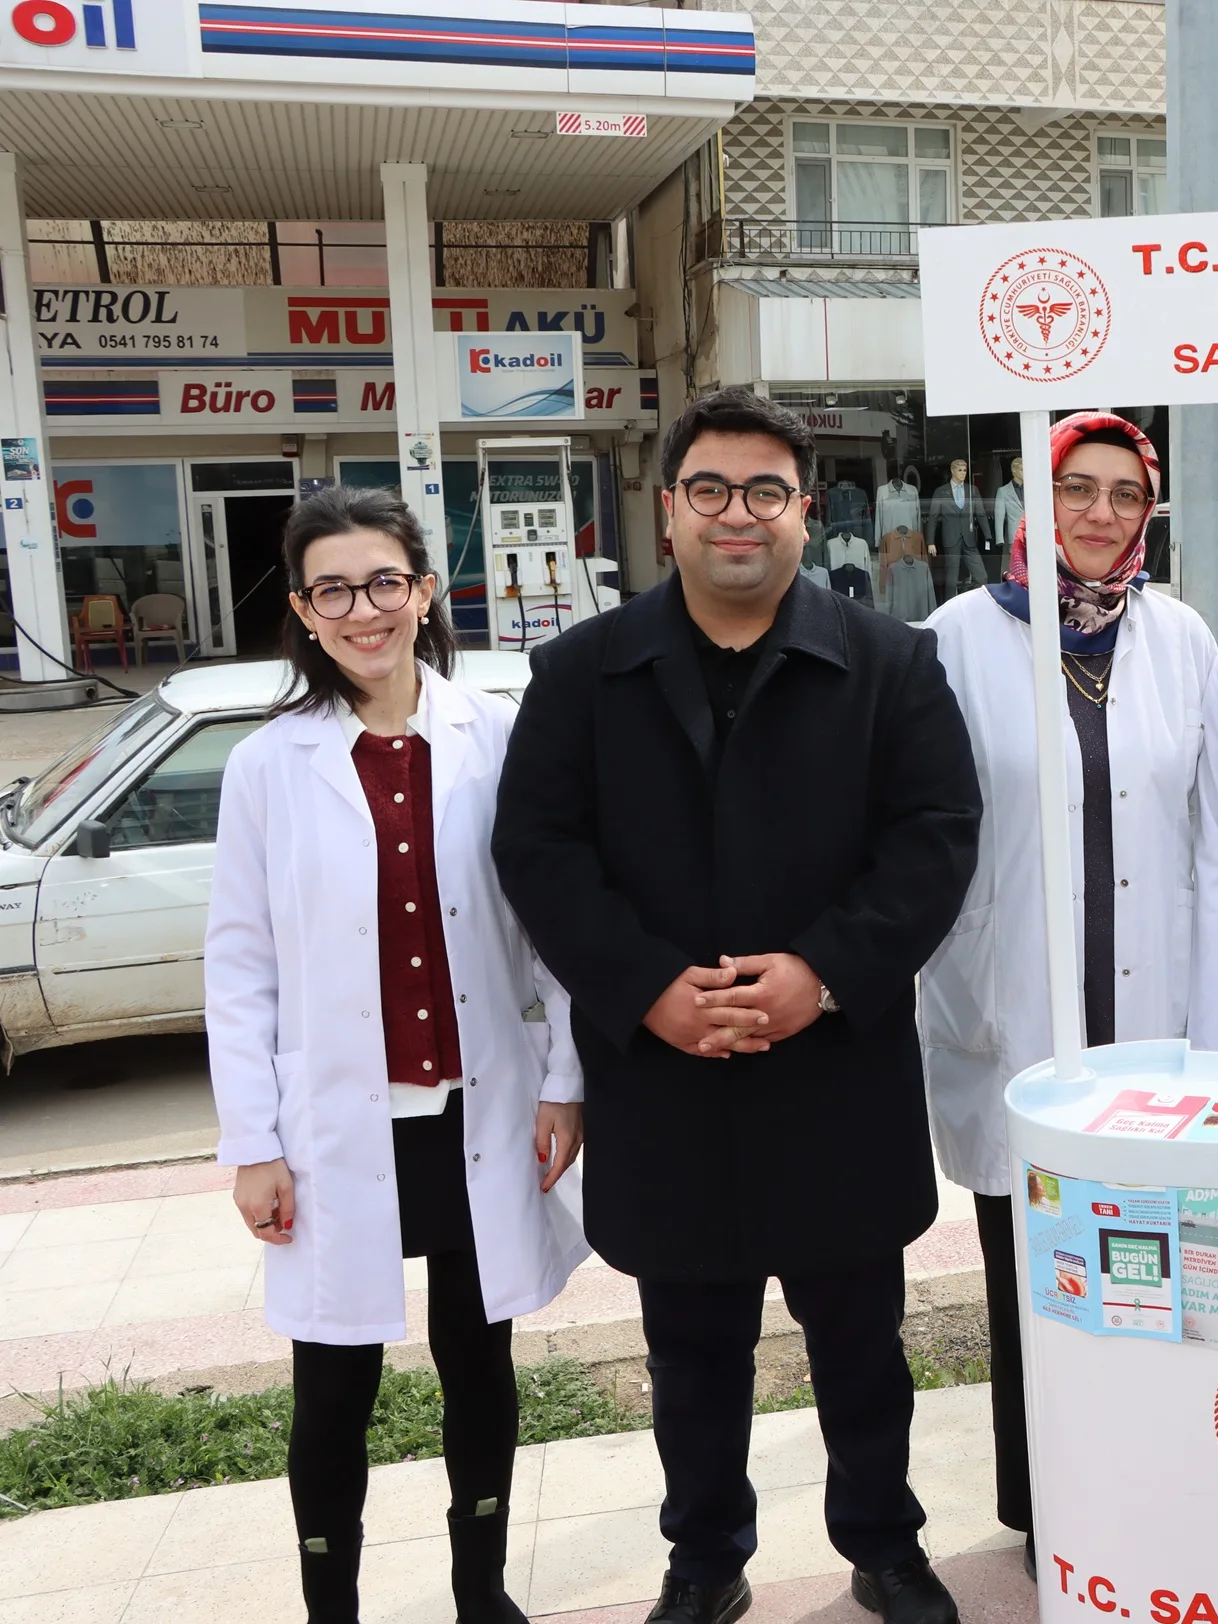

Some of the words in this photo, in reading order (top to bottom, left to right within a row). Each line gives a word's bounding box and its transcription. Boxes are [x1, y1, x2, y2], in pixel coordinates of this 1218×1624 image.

[584, 119, 621, 131] 5.20m
[1003, 271, 1051, 315] CUMHURİYETİ
[1054, 274, 1082, 299] SAĞLIK
[287, 309, 489, 345] MUU
[505, 303, 606, 345] AKÜ
[1066, 301, 1087, 350] BAKANLIĞI
[38, 332, 82, 349] YA
[98, 335, 136, 348] 0541
[142, 335, 171, 348] 795
[176, 335, 194, 348] 81
[200, 335, 219, 348] 74
[1003, 318, 1028, 353] TÜRKİYE
[493, 353, 563, 368] kadoil
[180, 381, 276, 414] Büro
[10, 499, 18, 508] 2
[1112, 1251, 1158, 1264] BUGÜN
[1112, 1262, 1159, 1282] GEL!
[1181, 1287, 1209, 1300] ADIM
[1181, 1300, 1206, 1314] VAR
[1053, 1553, 1131, 1618] T.C.
